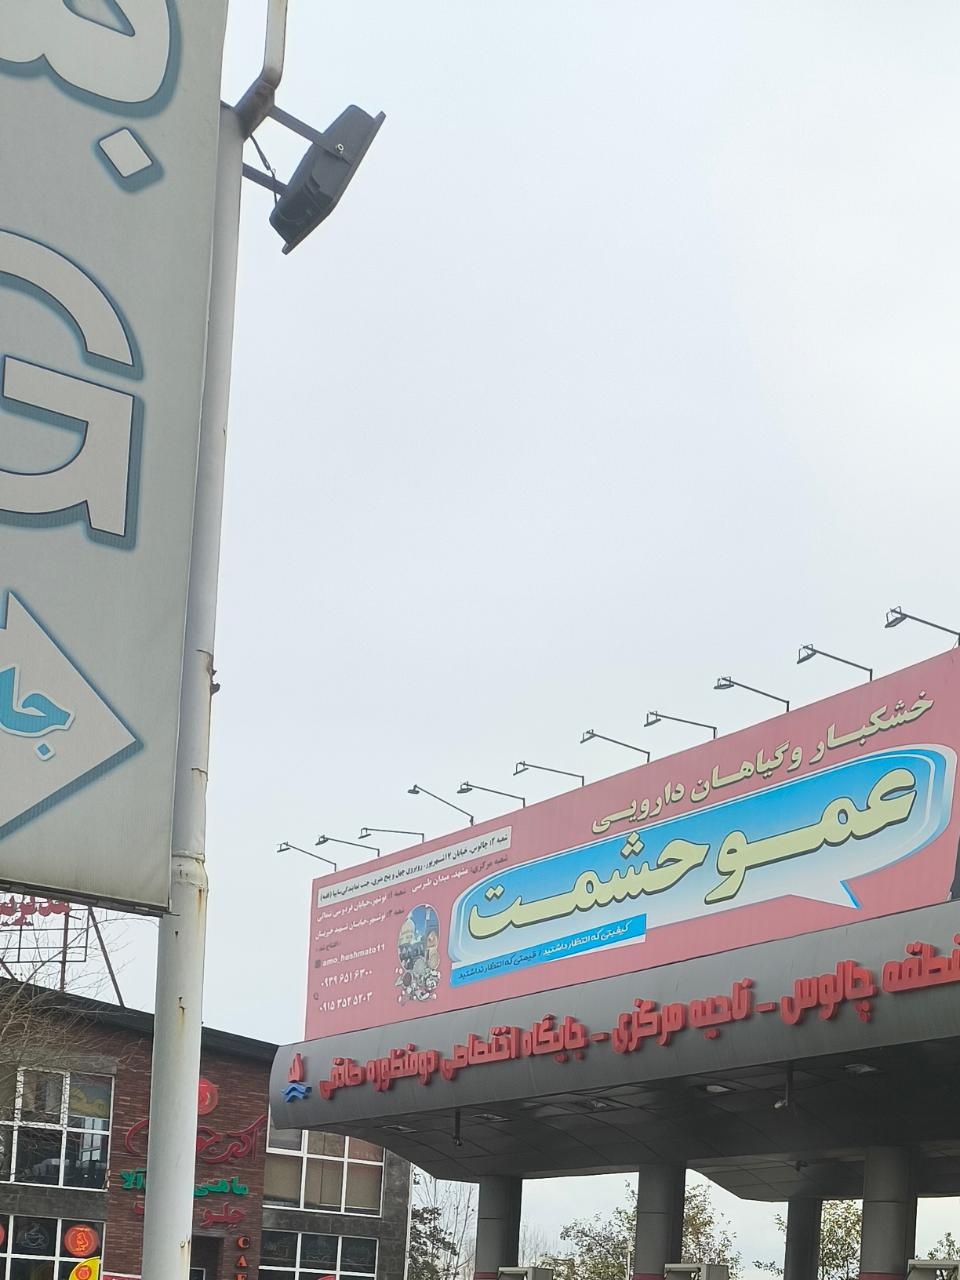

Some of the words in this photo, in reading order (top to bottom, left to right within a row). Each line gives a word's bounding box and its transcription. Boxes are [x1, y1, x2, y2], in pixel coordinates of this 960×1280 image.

[812, 690, 934, 763] خشکبار
[591, 779, 685, 834] دارویی
[704, 768, 917, 904] عمو
[468, 831, 709, 939] حشمت
[600, 920, 631, 941] کیفیتی
[689, 977, 755, 1040] ناحیه
[780, 960, 878, 1025] چالوس
[522, 1014, 588, 1064] جایگاه
[611, 998, 686, 1053] مرکزی
